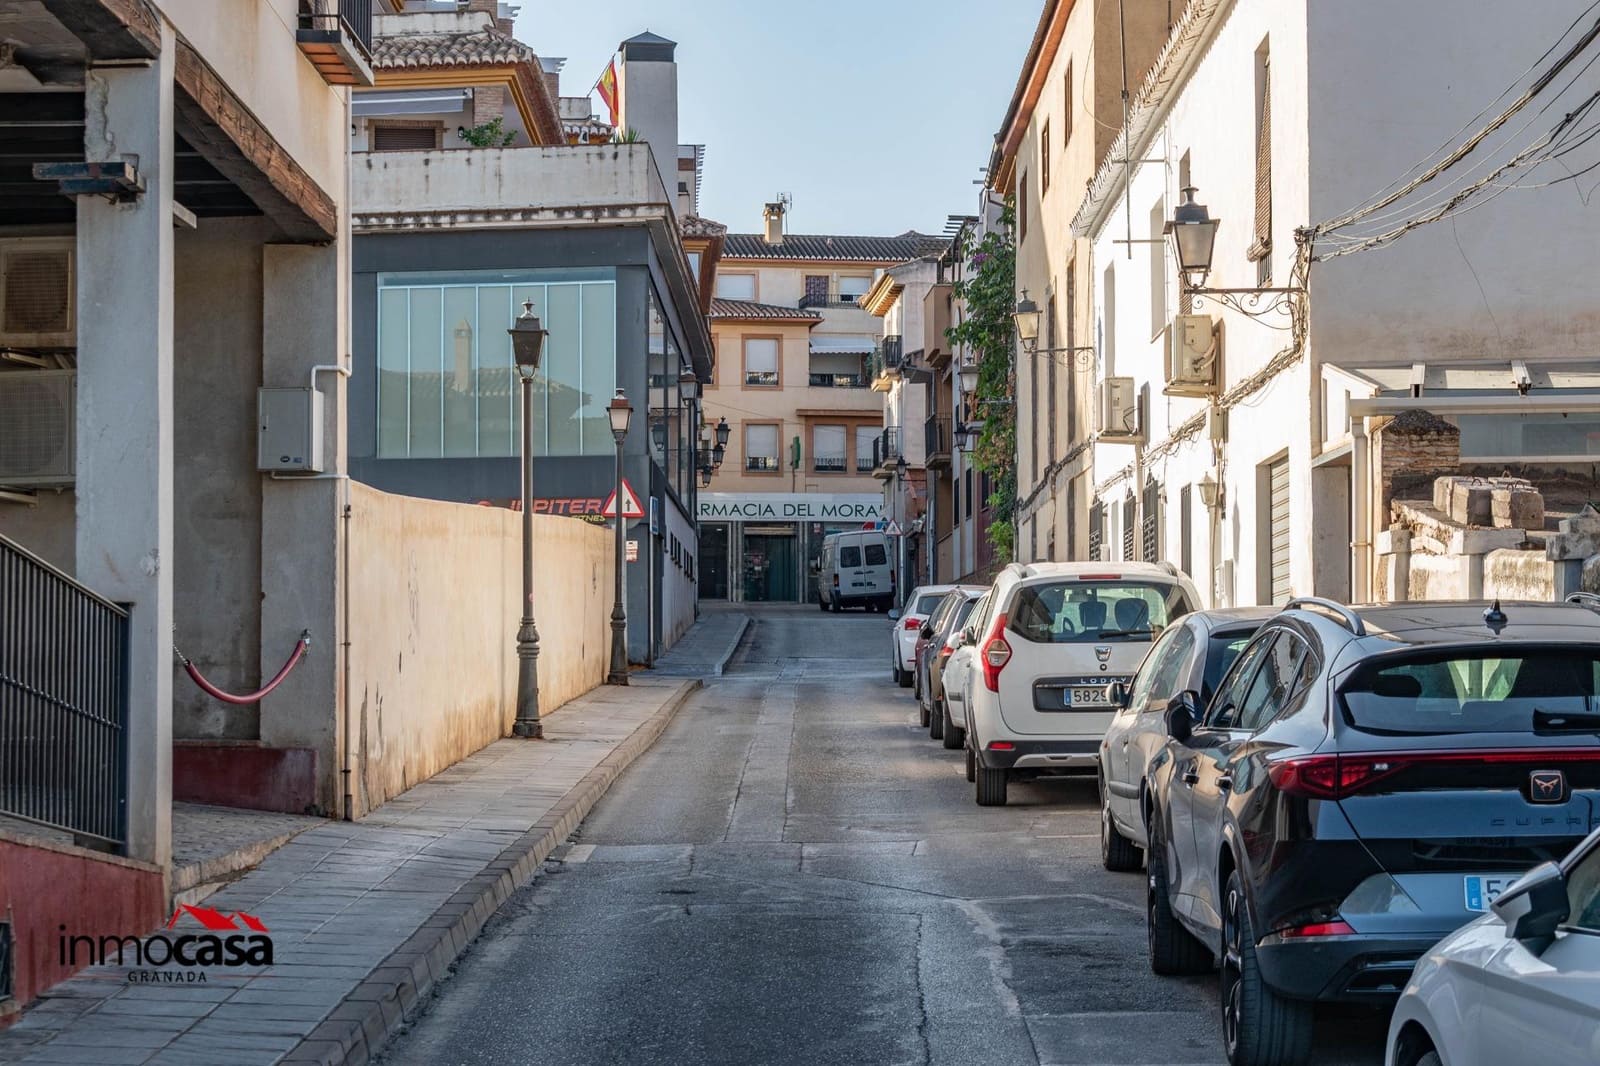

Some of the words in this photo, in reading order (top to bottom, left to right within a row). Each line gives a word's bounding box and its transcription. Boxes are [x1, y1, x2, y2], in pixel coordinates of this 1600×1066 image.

[697, 503, 776, 517] RMACIA
[783, 503, 815, 517] DEL
[1486, 879, 1516, 903] 5
